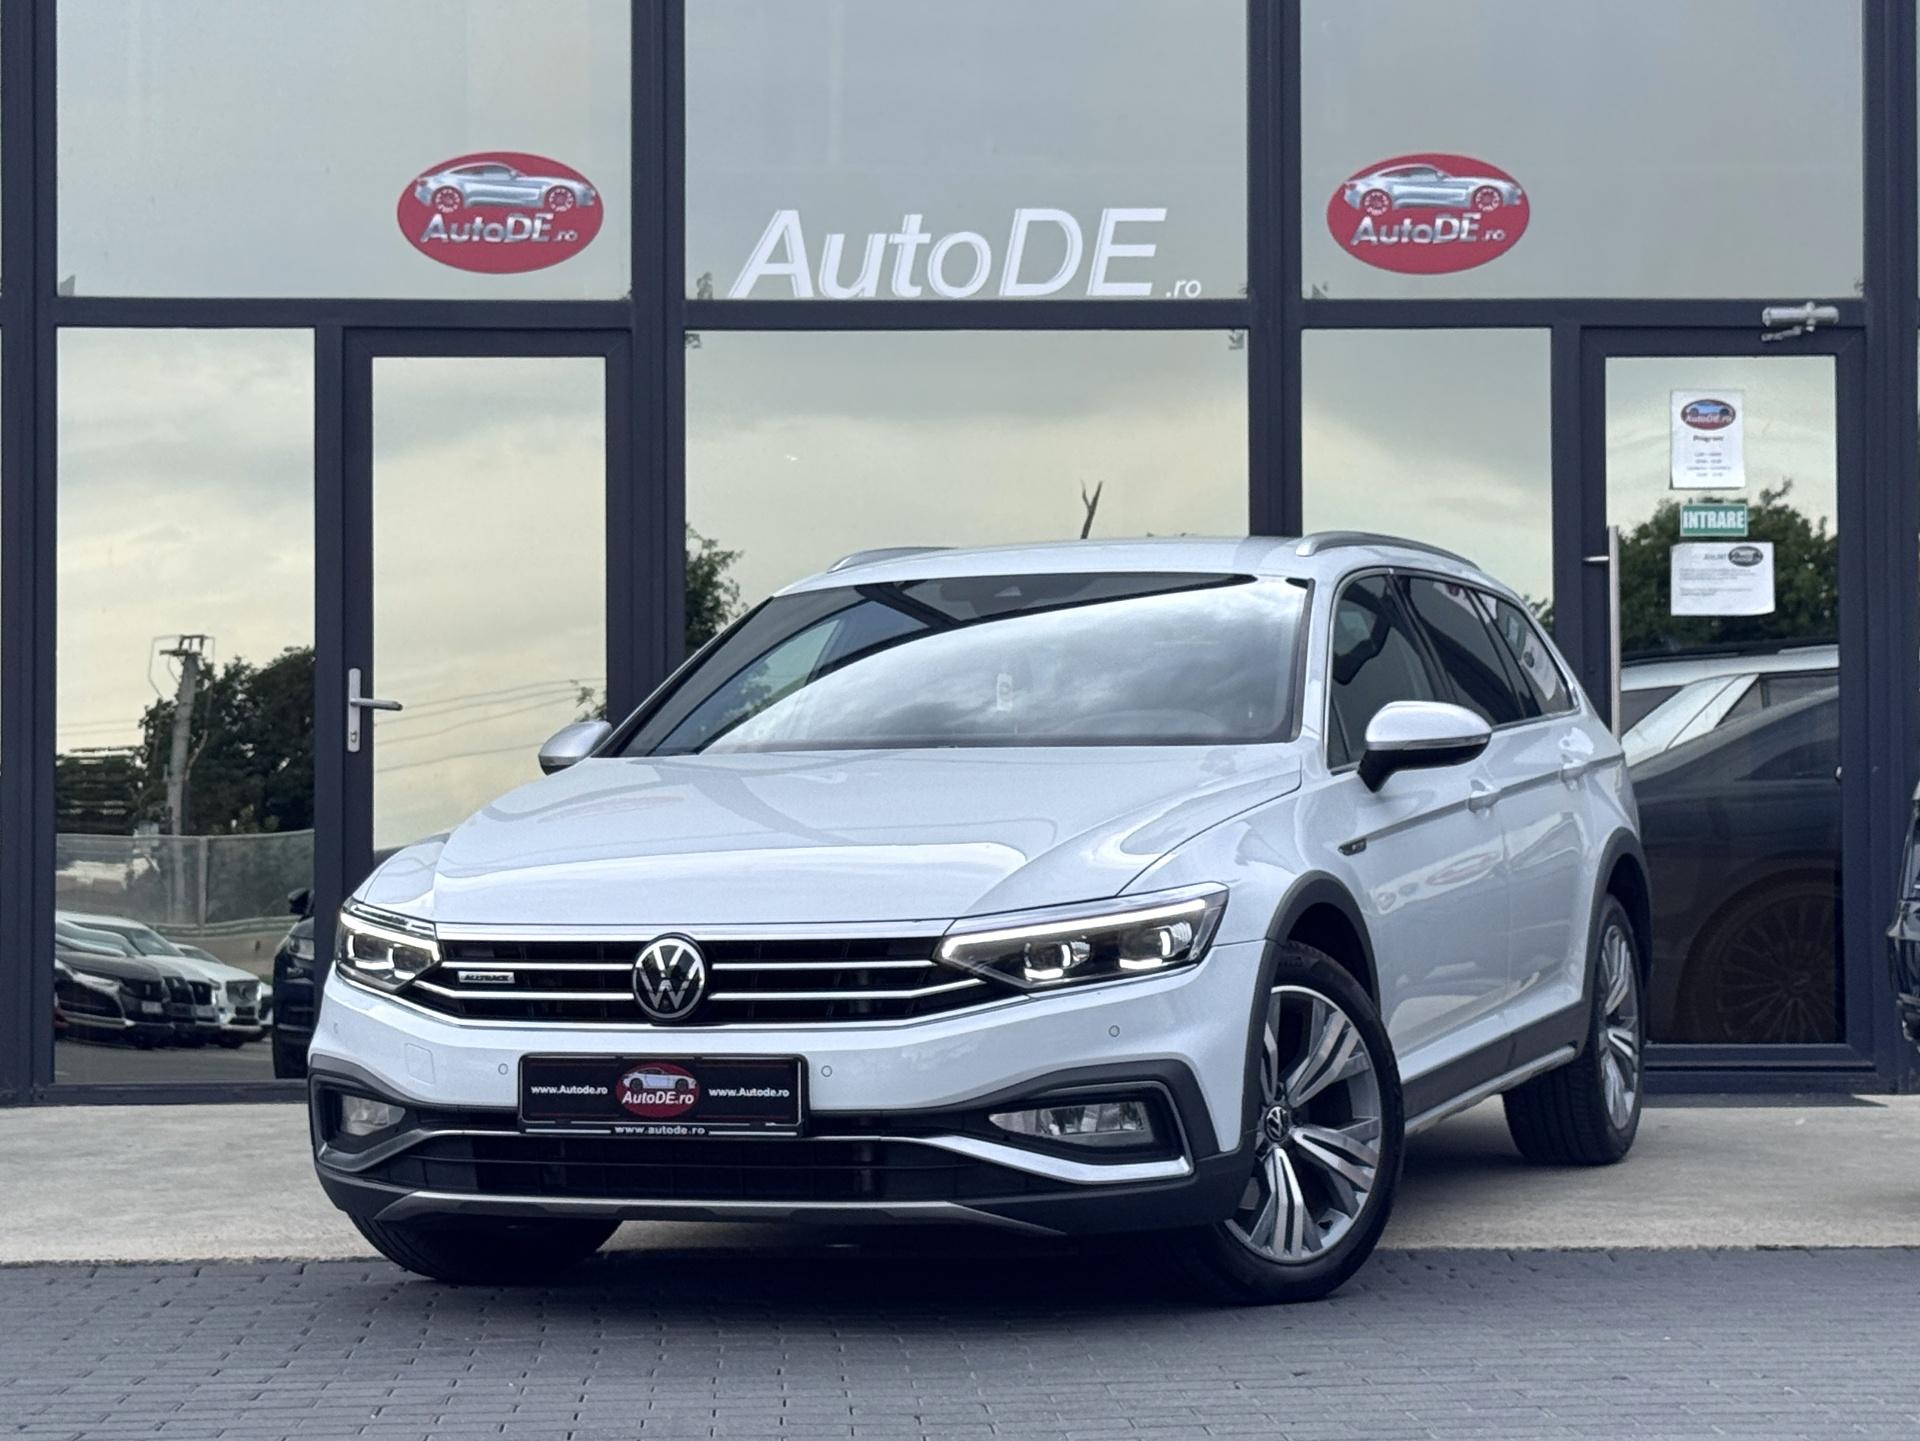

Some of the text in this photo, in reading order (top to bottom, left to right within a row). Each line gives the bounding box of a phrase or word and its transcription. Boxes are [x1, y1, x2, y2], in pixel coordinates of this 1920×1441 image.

[1682, 510, 1745, 529] INTRARE
[531, 1085, 790, 1105] www.Autode.ro AutoDE.ro www.Autode.ro
[614, 1125, 706, 1136] www.autode.ro
